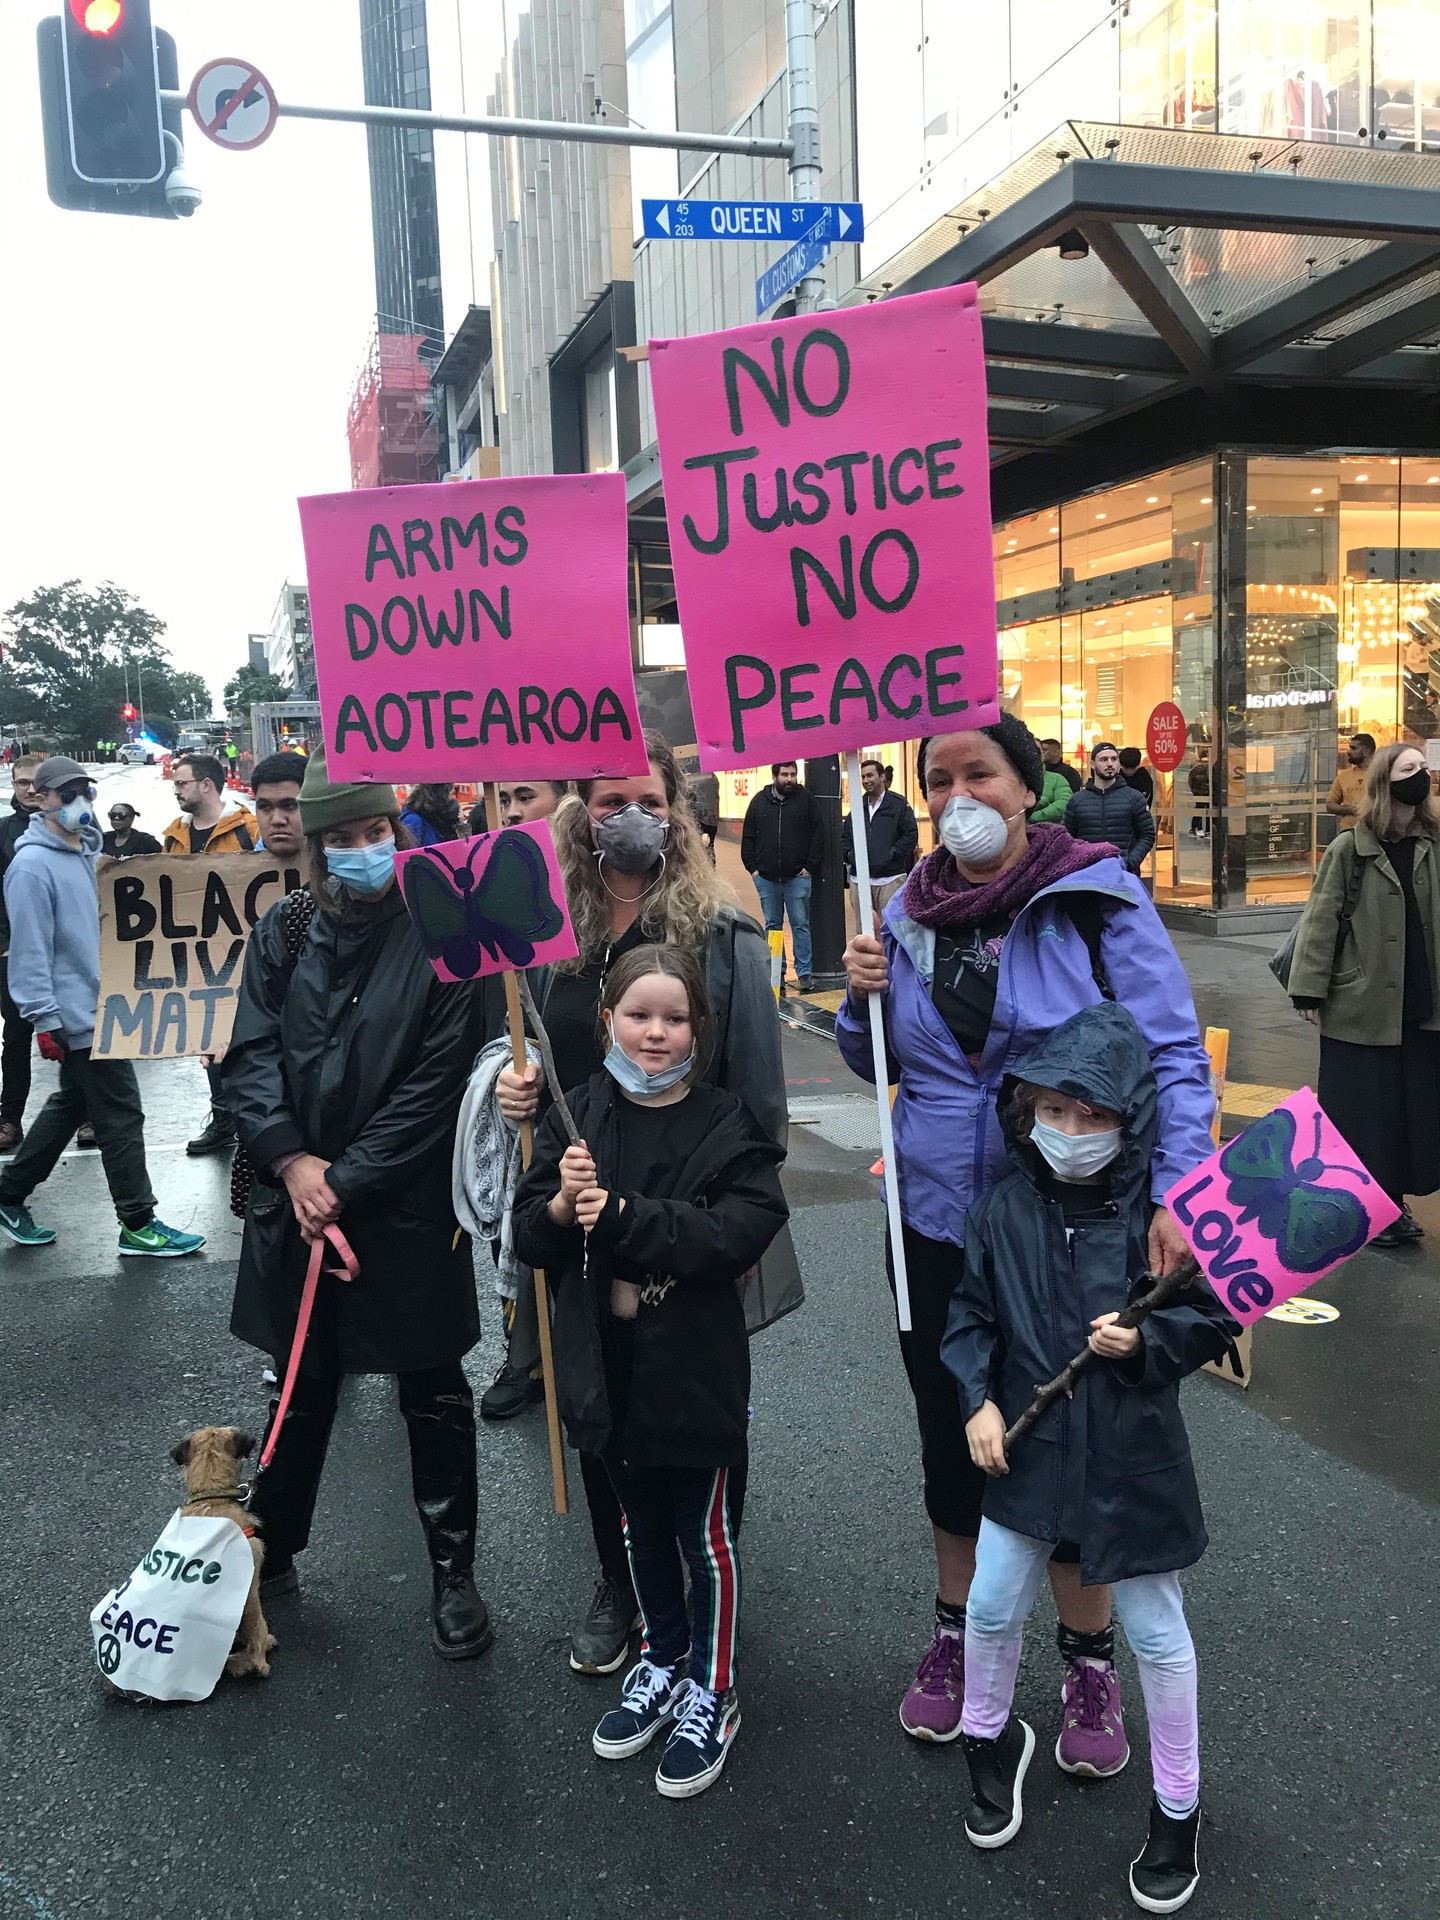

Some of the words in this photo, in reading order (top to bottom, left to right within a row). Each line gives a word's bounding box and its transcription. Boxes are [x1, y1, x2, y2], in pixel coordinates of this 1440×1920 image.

[674, 224, 694, 237] 203
[676, 203, 689, 215] 45
[711, 206, 781, 234] QUEEN
[791, 208, 804, 222] ST
[772, 243, 806, 296] CUSTOMS
[723, 328, 850, 436] NO
[365, 506, 529, 582] ARMS
[789, 528, 920, 627] NO
[345, 585, 512, 661] DOWN
[335, 686, 633, 754] AOTEAROA
[725, 644, 969, 753] PEACE
[1153, 715, 1179, 731] SALE
[1154, 739, 1178, 754] 50%
[134, 938, 245, 990] LIV
[100, 986, 241, 1055] MAT
